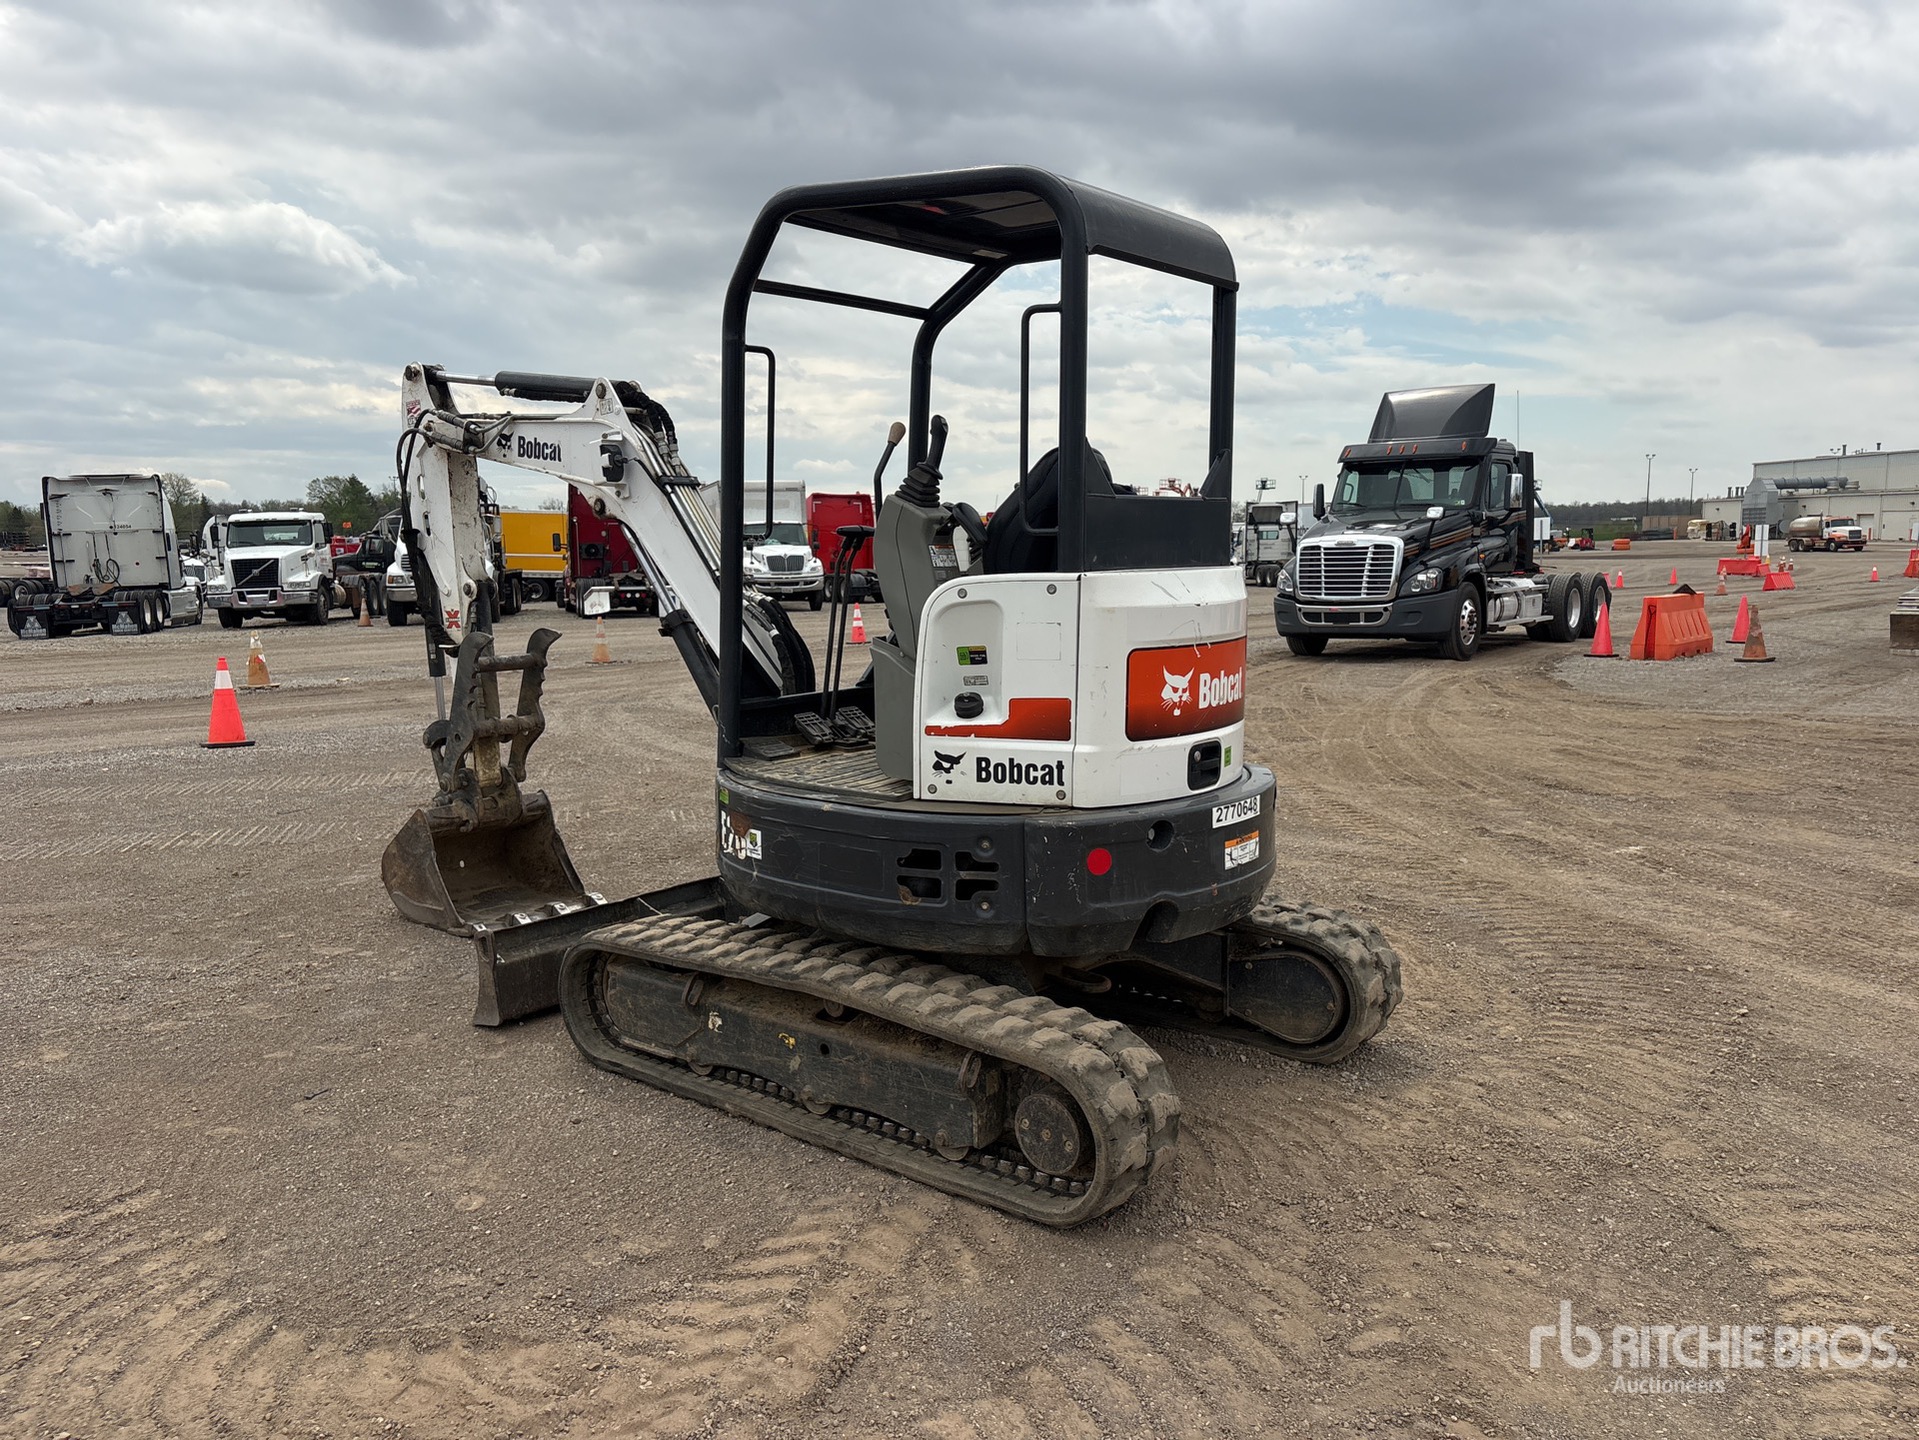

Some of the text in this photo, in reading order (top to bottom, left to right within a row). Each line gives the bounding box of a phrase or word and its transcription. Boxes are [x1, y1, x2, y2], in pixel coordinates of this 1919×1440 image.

[518, 435, 562, 462] Bobcat
[1199, 667, 1242, 709] Bobcat
[976, 757, 1065, 786] Bobcat
[1216, 796, 1258, 823] 2770648
